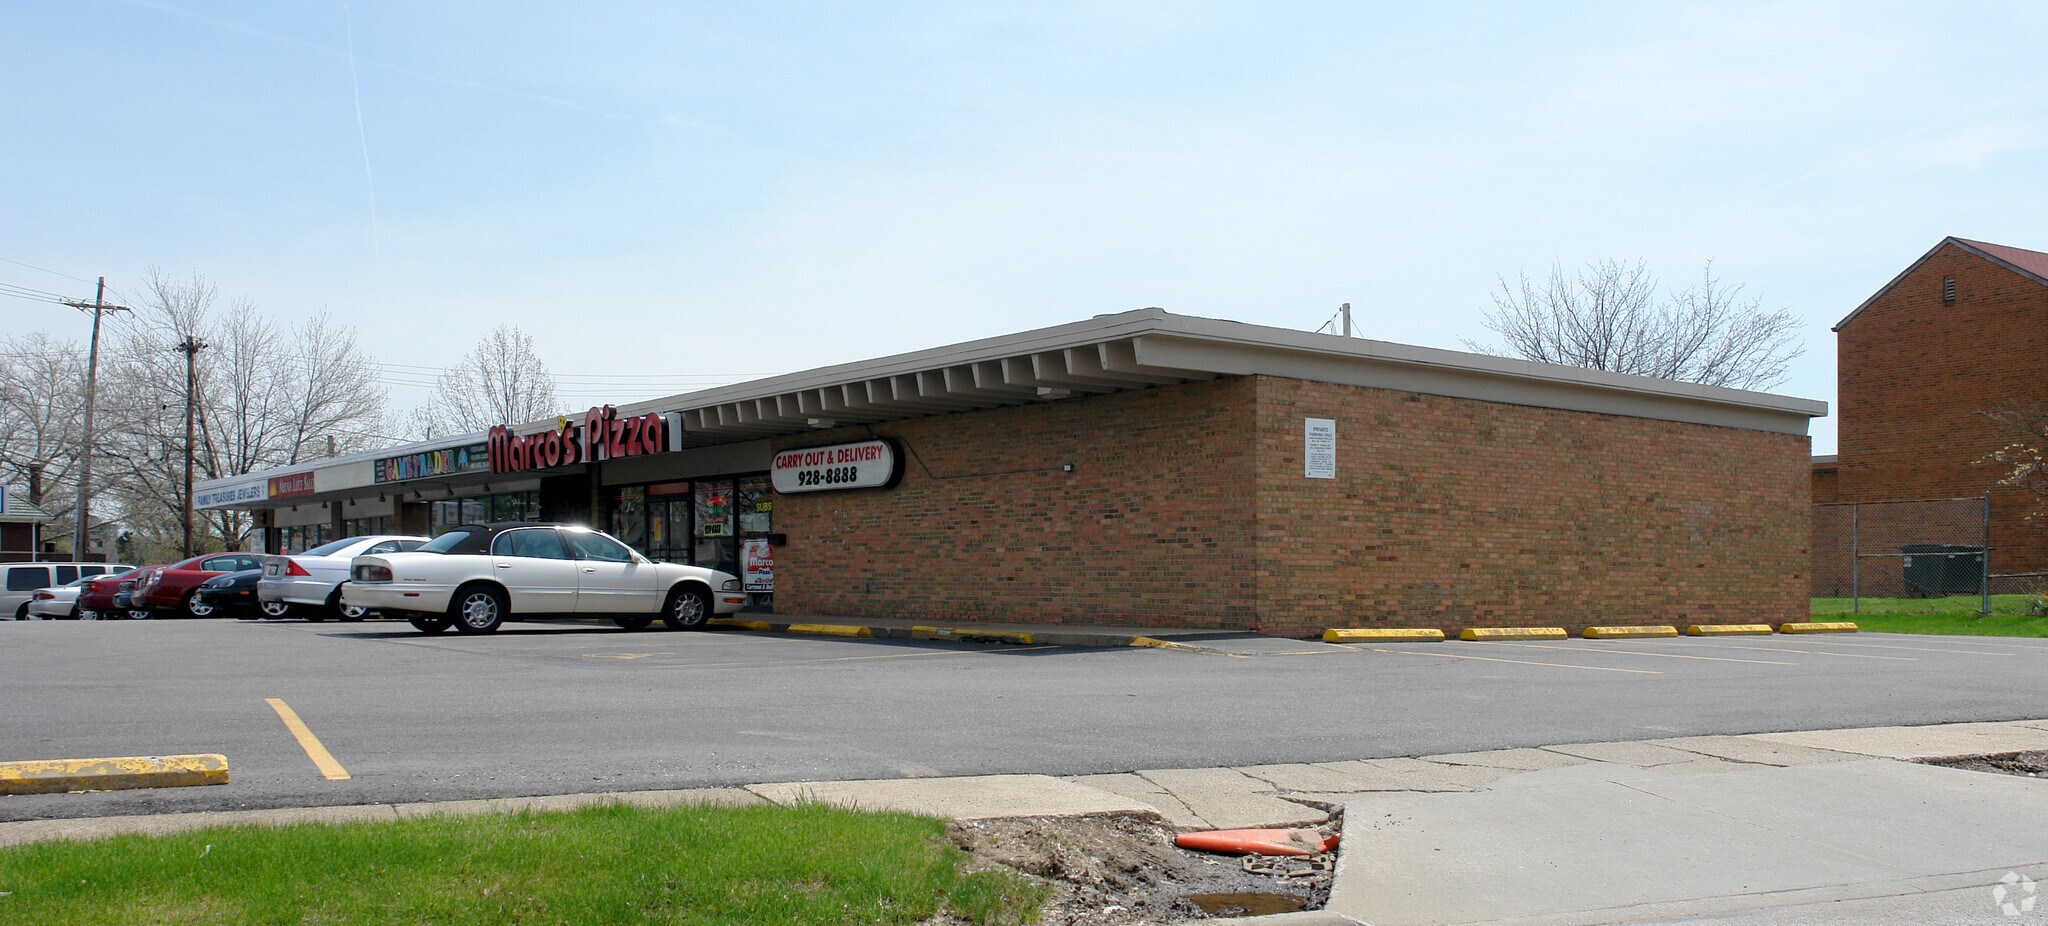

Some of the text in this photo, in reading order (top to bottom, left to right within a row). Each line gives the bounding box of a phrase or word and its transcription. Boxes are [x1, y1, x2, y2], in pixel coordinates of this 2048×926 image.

[488, 404, 662, 474] Marco's Pizza
[776, 445, 883, 469] CARRY OUT & DELIVERY
[798, 466, 857, 486] 928-8888
[198, 486, 260, 506] FAMILY TREASURES JEWELERS
[756, 502, 772, 512] SUBS
